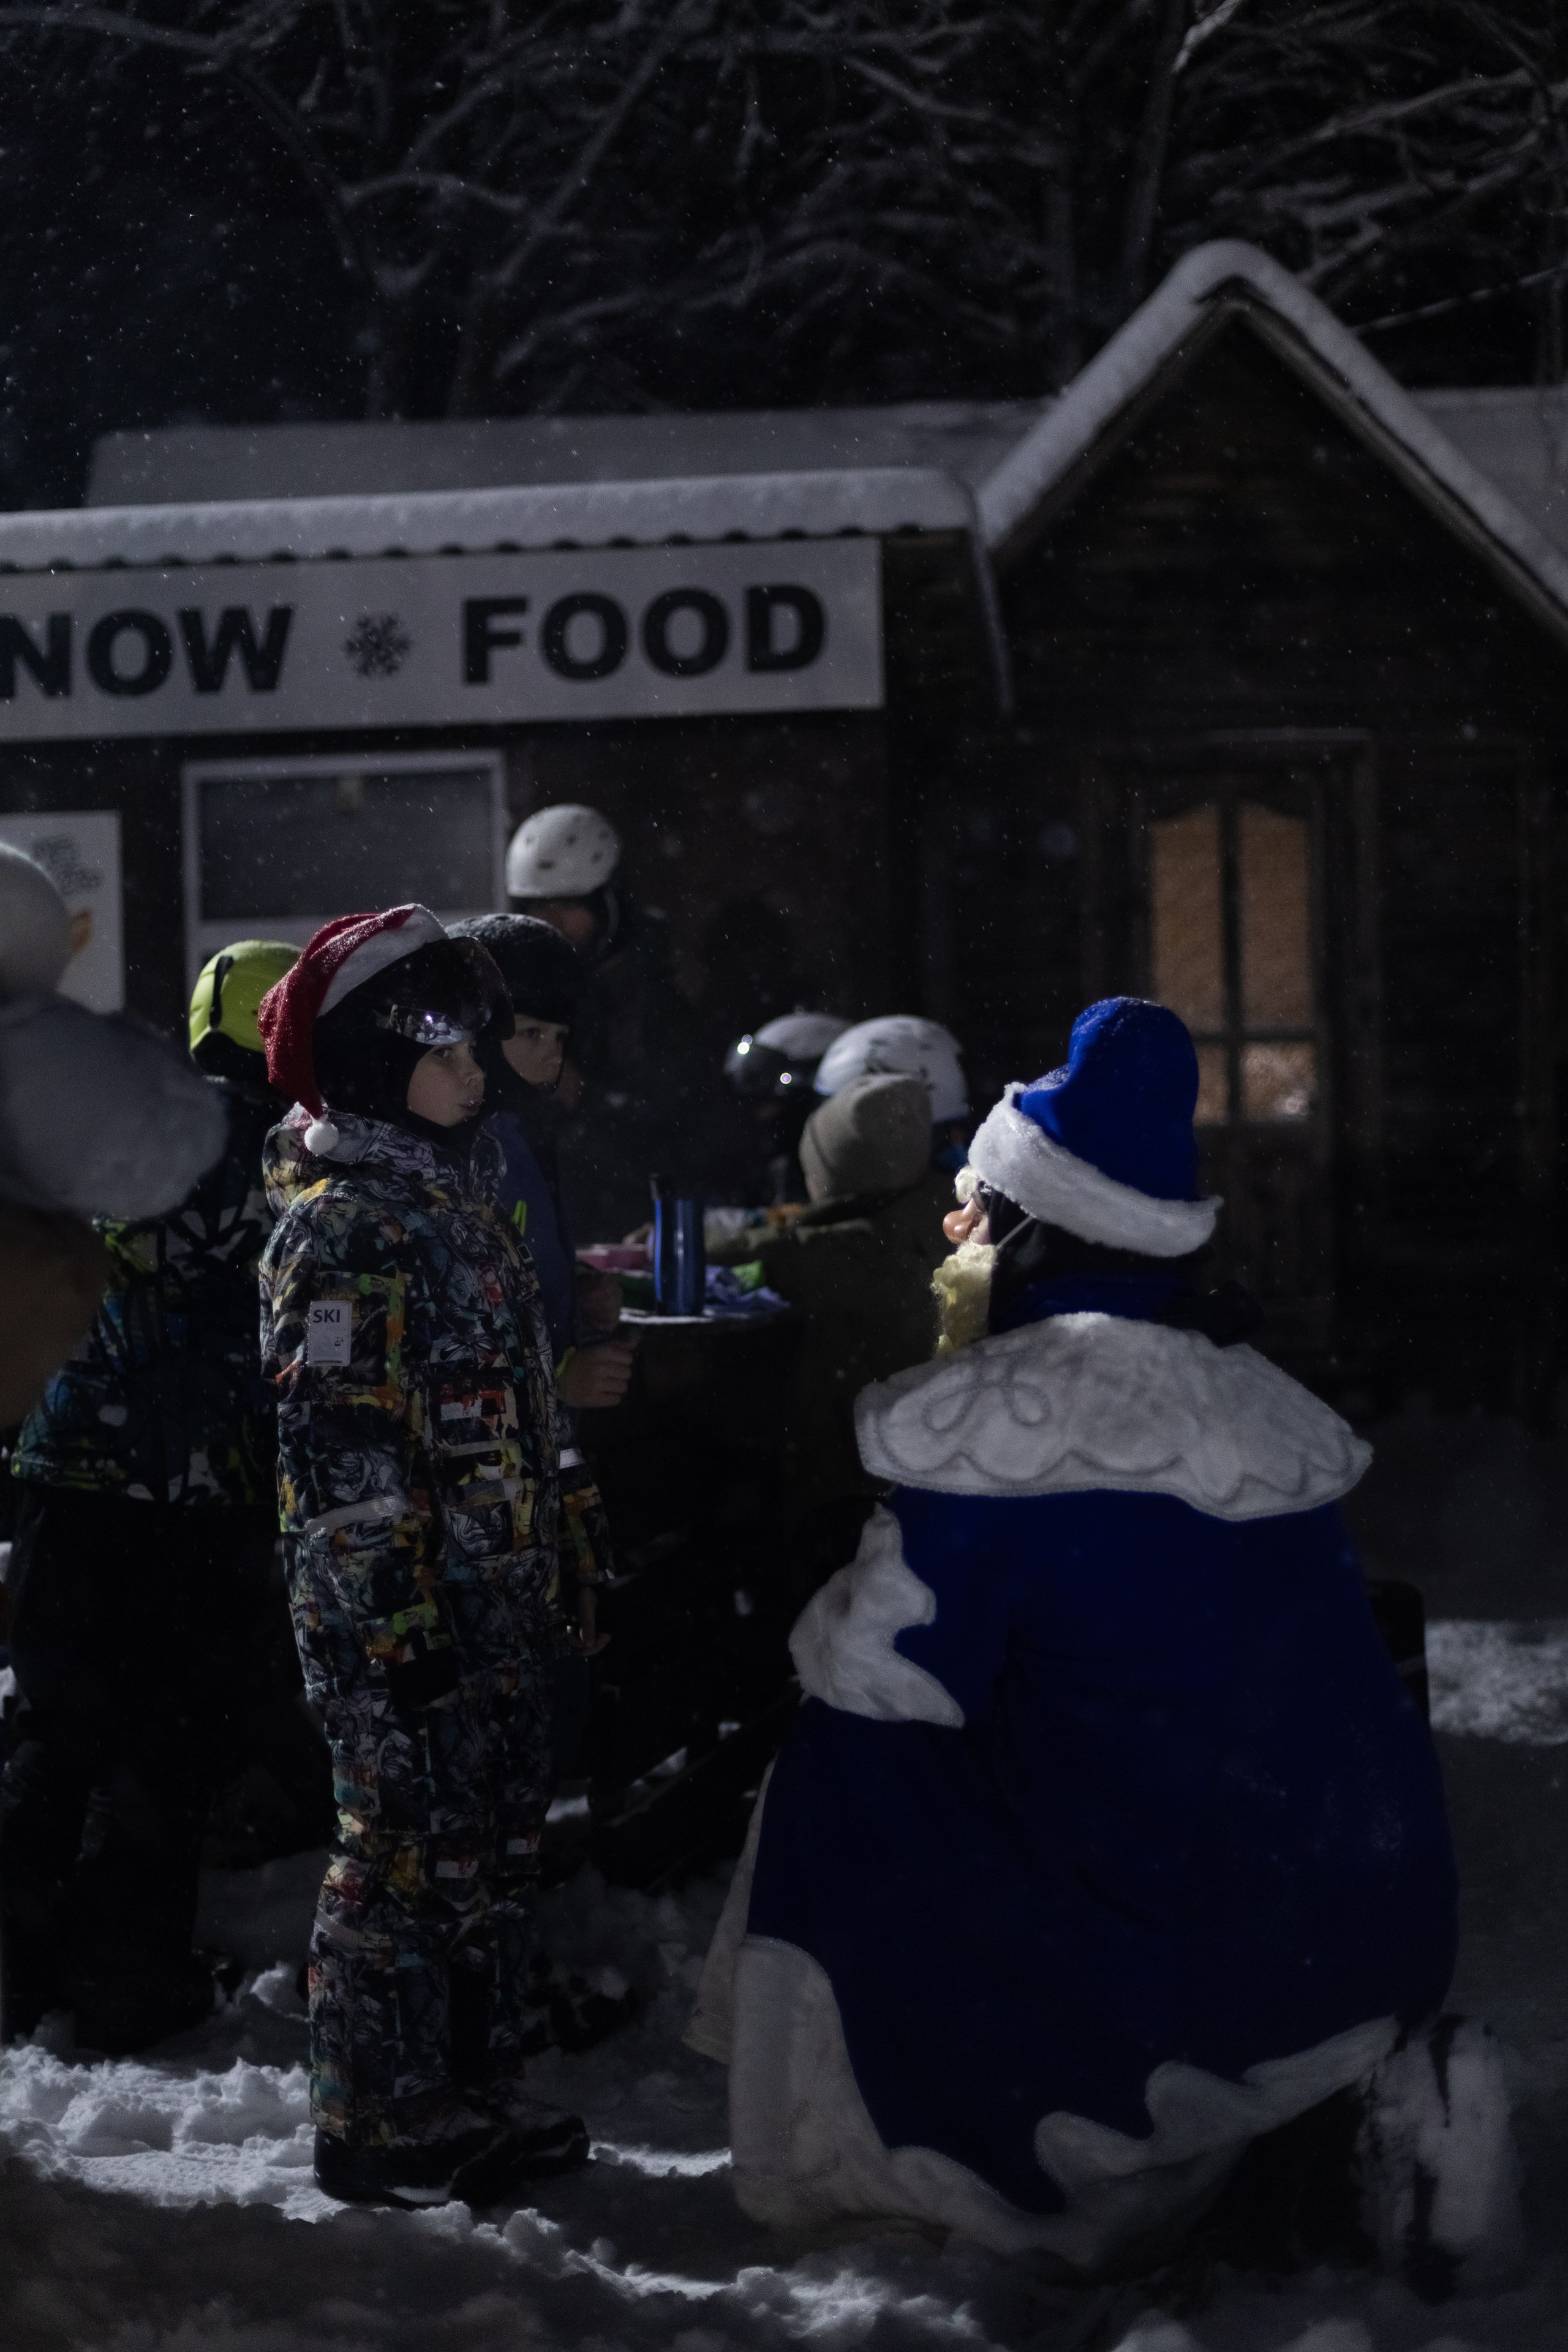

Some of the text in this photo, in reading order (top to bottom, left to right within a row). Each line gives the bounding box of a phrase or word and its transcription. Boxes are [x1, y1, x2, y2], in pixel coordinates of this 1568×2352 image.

[0, 584, 824, 700] NOW FOOD
[313, 1309, 341, 1323] SKI
